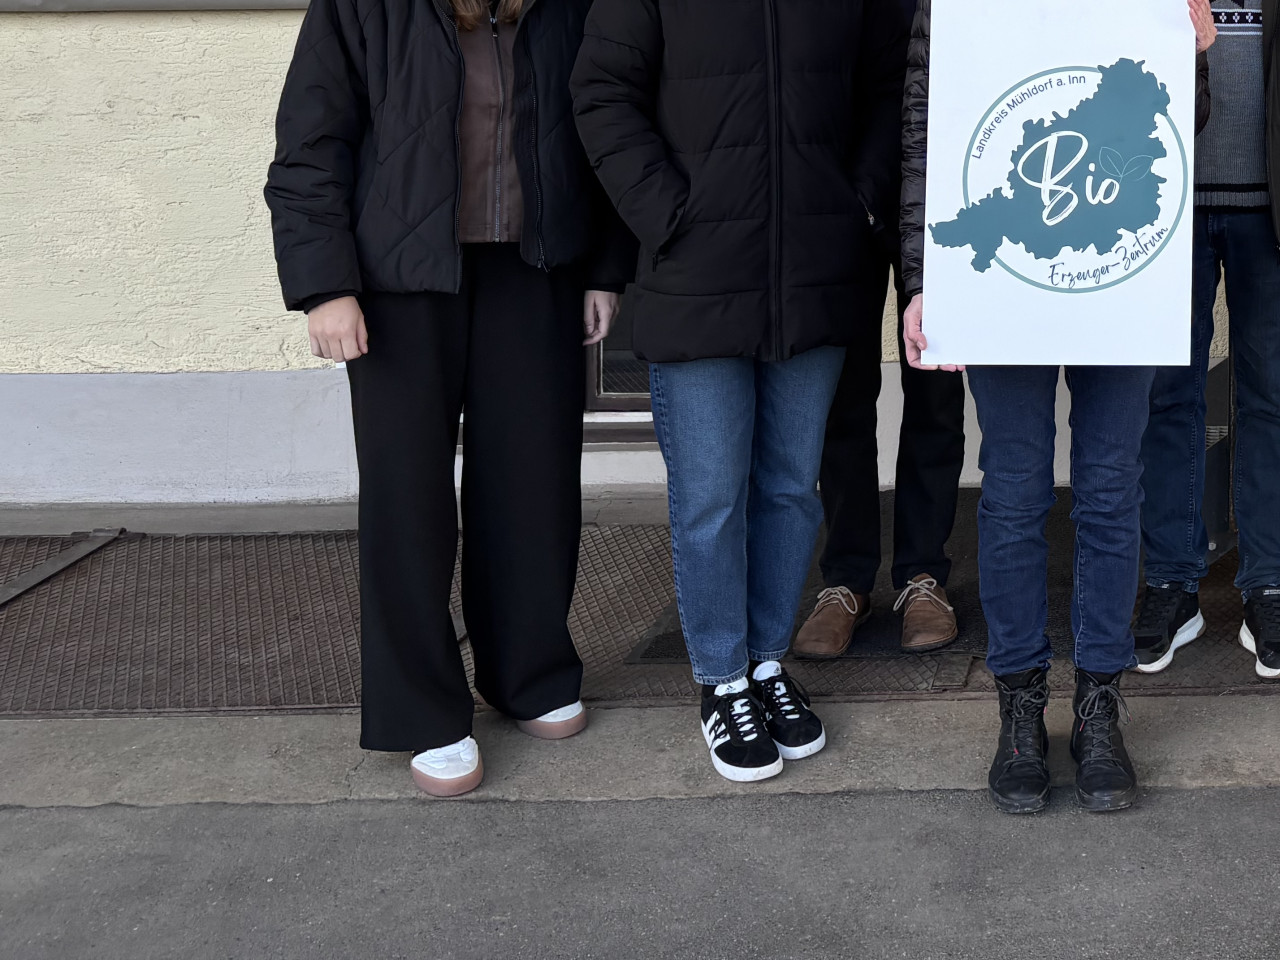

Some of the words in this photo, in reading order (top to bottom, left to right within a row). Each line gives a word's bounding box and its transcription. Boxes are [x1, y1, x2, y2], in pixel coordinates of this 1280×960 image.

[972, 109, 1008, 159] Landkreis
[1006, 78, 1053, 110] Mühldorf
[1068, 75, 1086, 84] Inn
[1017, 130, 1120, 226] Bio
[1048, 227, 1168, 289] Erzeuger-Zentrum
